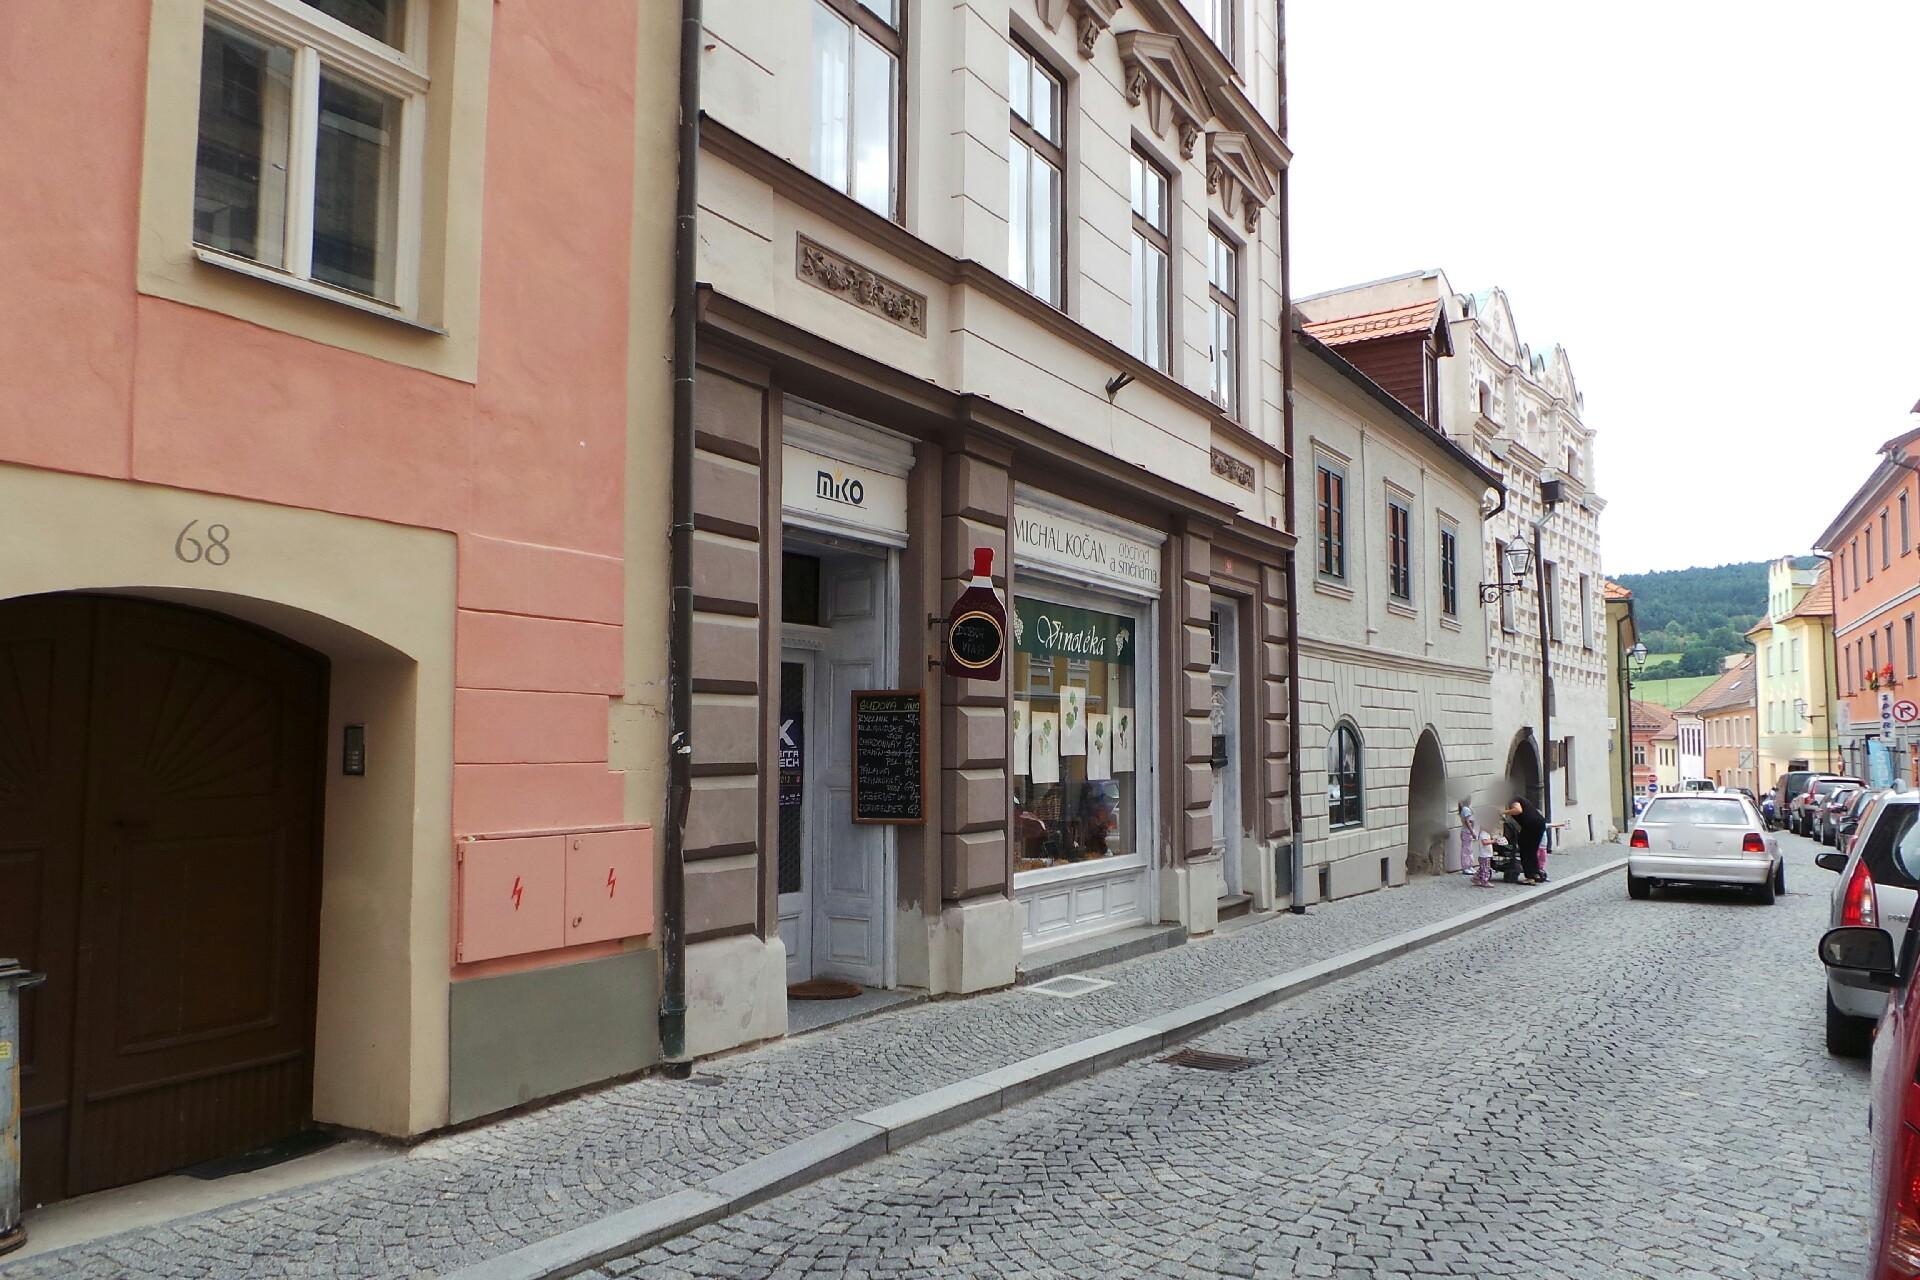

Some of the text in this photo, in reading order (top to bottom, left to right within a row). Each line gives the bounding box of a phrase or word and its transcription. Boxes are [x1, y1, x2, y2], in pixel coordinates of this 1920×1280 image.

[175, 519, 230, 566] 68
[1013, 517, 1107, 565] MICHAL KOČAN
[1118, 542, 1150, 565] obchod
[1109, 556, 1116, 572] a
[1036, 615, 1107, 656] Vinotéka
[1881, 694, 1891, 738] SPORT
